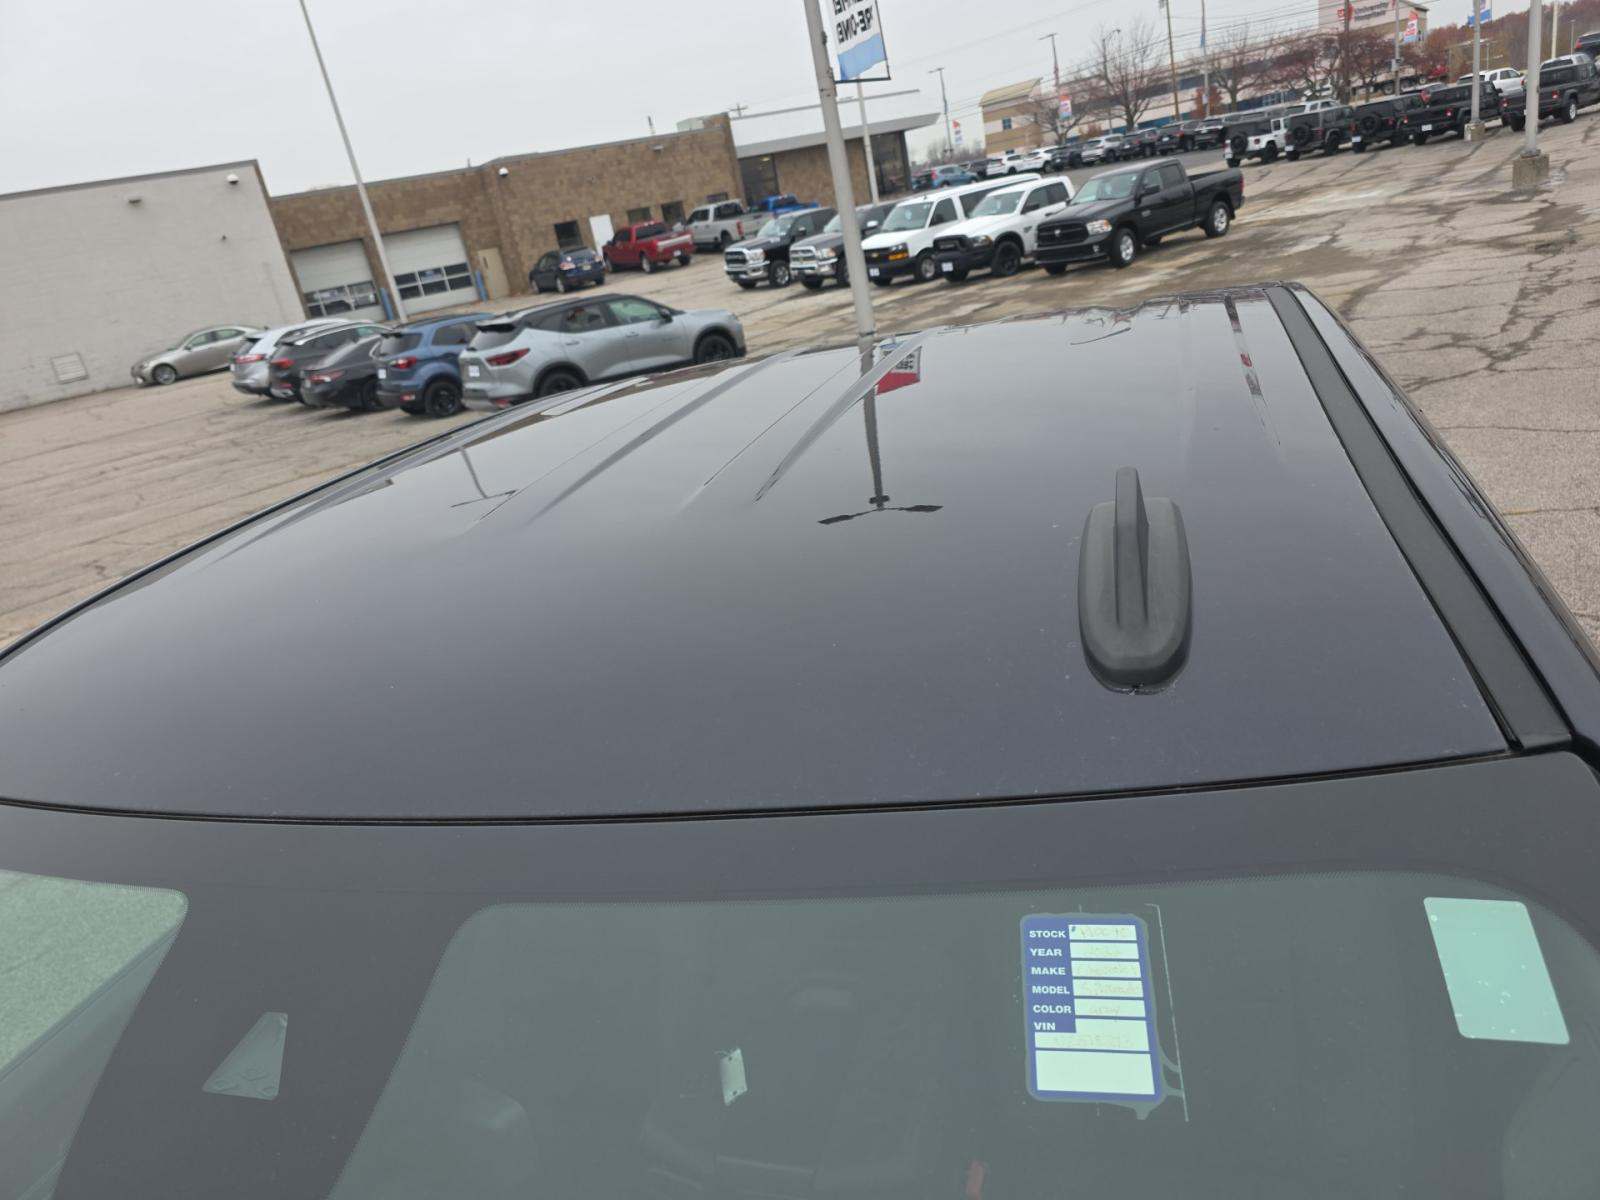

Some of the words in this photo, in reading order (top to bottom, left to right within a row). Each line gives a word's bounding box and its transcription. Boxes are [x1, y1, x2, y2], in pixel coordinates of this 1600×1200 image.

[1029, 930, 1067, 939] STOCK
[1030, 948, 1063, 957] YEAR
[1031, 967, 1067, 976] MAKE
[1032, 985, 1071, 995] MODEL
[1033, 1004, 1073, 1014] COLOR
[1034, 1022, 1057, 1031] VIN
